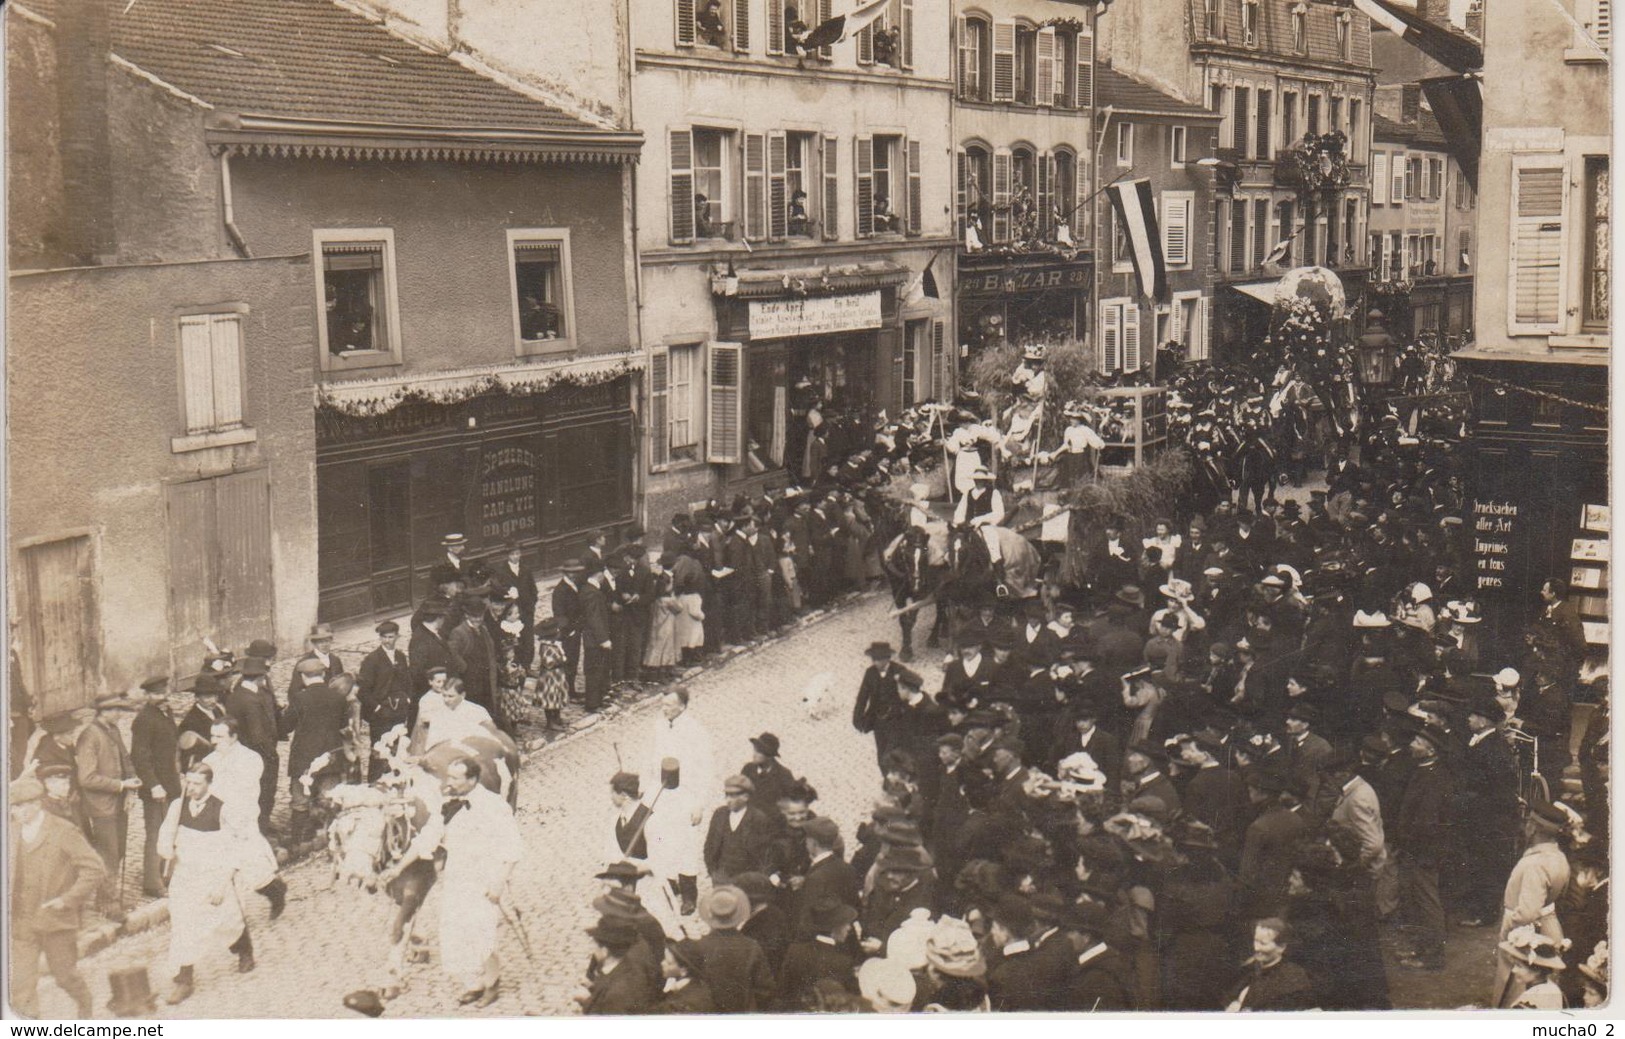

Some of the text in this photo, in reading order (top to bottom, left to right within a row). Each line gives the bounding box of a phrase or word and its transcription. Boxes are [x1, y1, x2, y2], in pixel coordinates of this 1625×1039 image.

[984, 271, 1062, 290] BZAR
[482, 475, 535, 498] HANDLUNG
[483, 499, 504, 518] EAU
[515, 494, 534, 511] VIE
[1475, 516, 1512, 533] aller Art
[1477, 557, 1505, 571] en tous
[1477, 575, 1502, 589] genres
